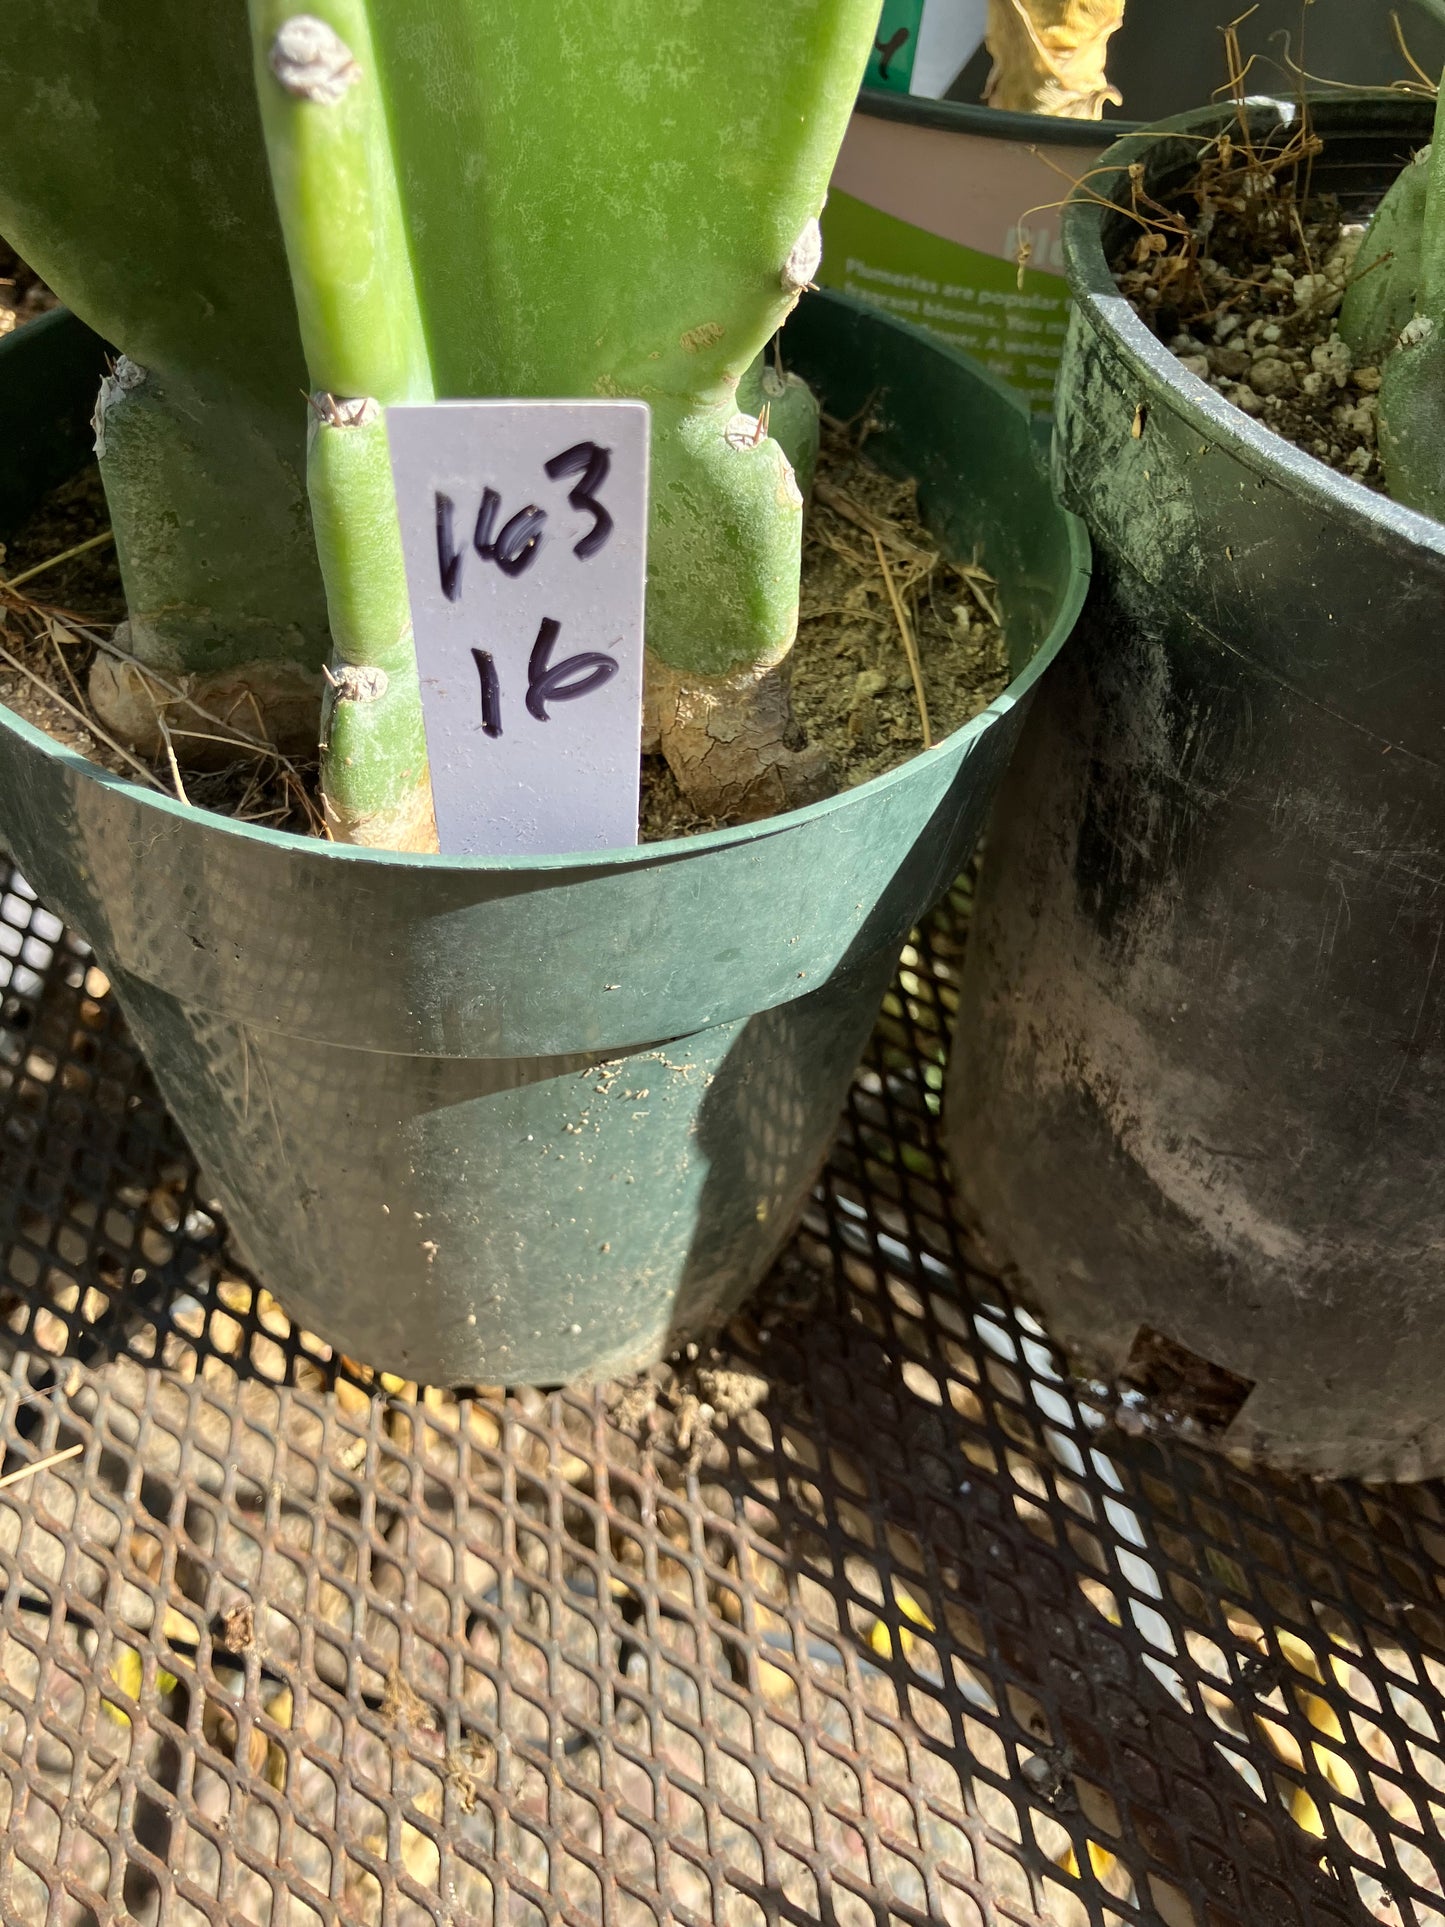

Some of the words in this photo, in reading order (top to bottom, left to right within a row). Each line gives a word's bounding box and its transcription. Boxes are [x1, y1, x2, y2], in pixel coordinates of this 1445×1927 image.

[845, 257, 937, 295] Plumerias
[942, 284, 975, 301] are
[978, 291, 1061, 311] popular
[435, 440, 614, 603] 163
[470, 616, 619, 738] 16
